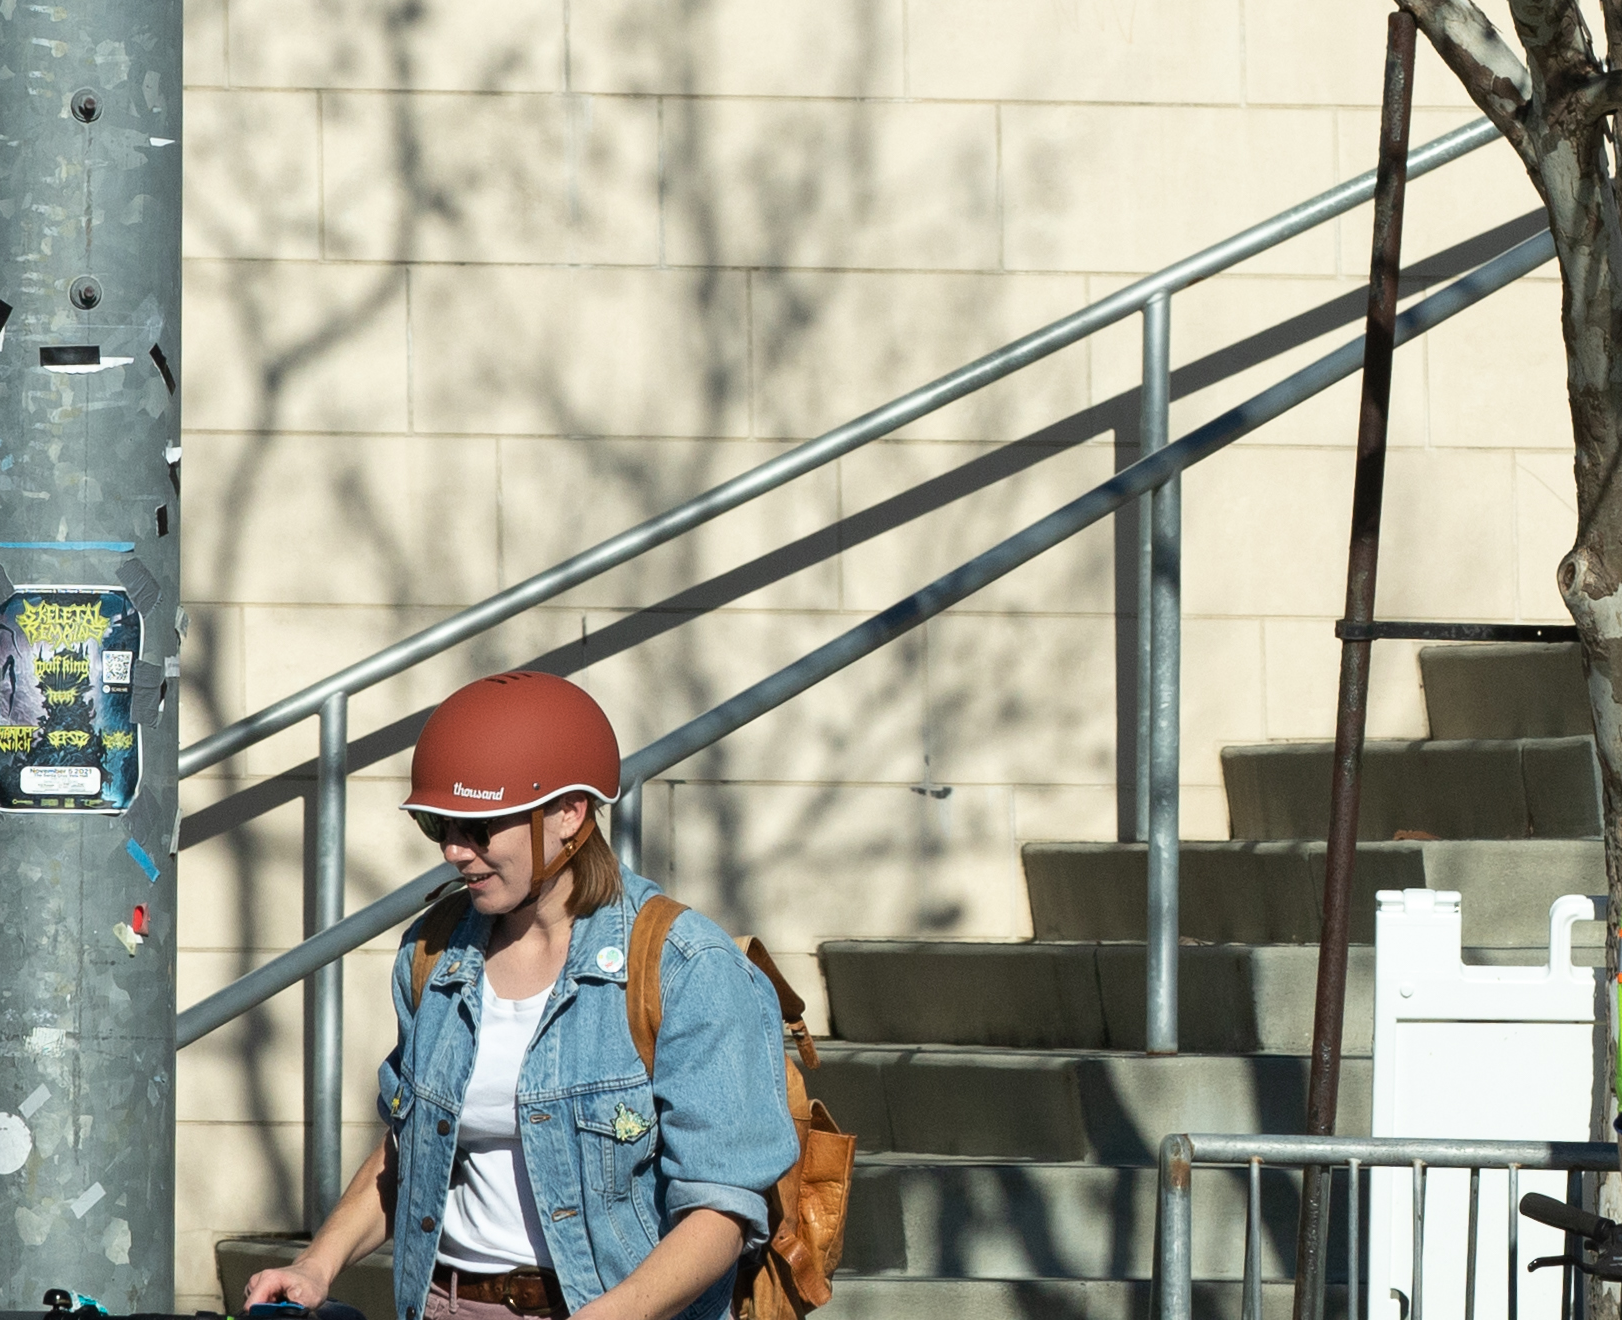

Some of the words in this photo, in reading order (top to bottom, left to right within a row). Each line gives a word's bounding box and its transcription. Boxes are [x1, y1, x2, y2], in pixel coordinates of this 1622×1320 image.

[16, 598, 110, 626] SKELETAL
[22, 622, 110, 651] REMAINS
[453, 781, 505, 801] thousand
